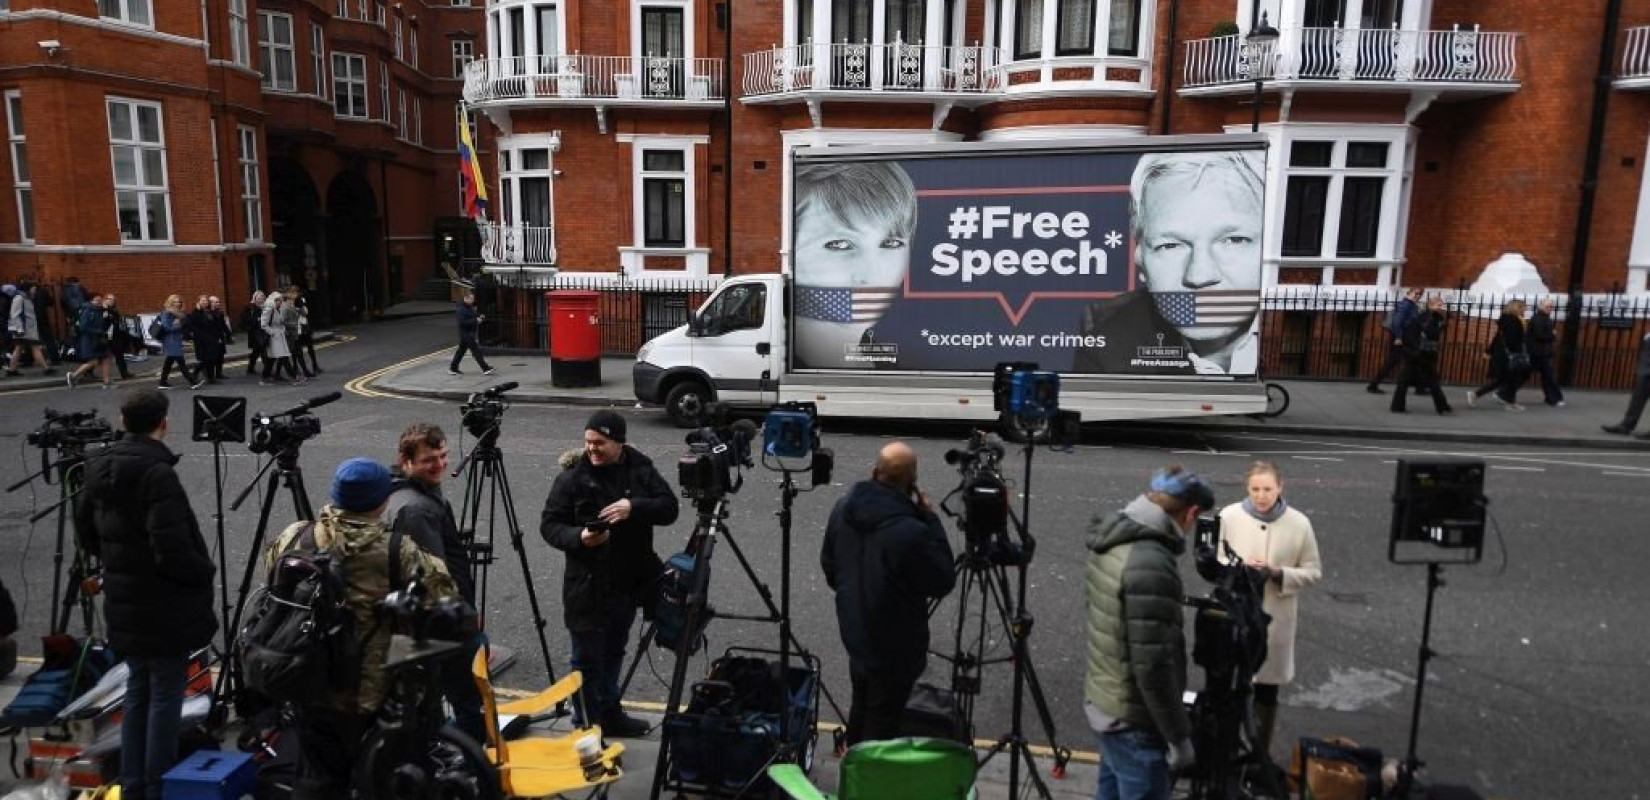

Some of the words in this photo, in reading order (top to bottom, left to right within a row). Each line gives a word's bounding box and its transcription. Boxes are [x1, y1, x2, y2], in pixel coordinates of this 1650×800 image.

[949, 206, 1090, 239] #Free
[999, 334, 1034, 347] war
[1040, 332, 1106, 347] crimes
